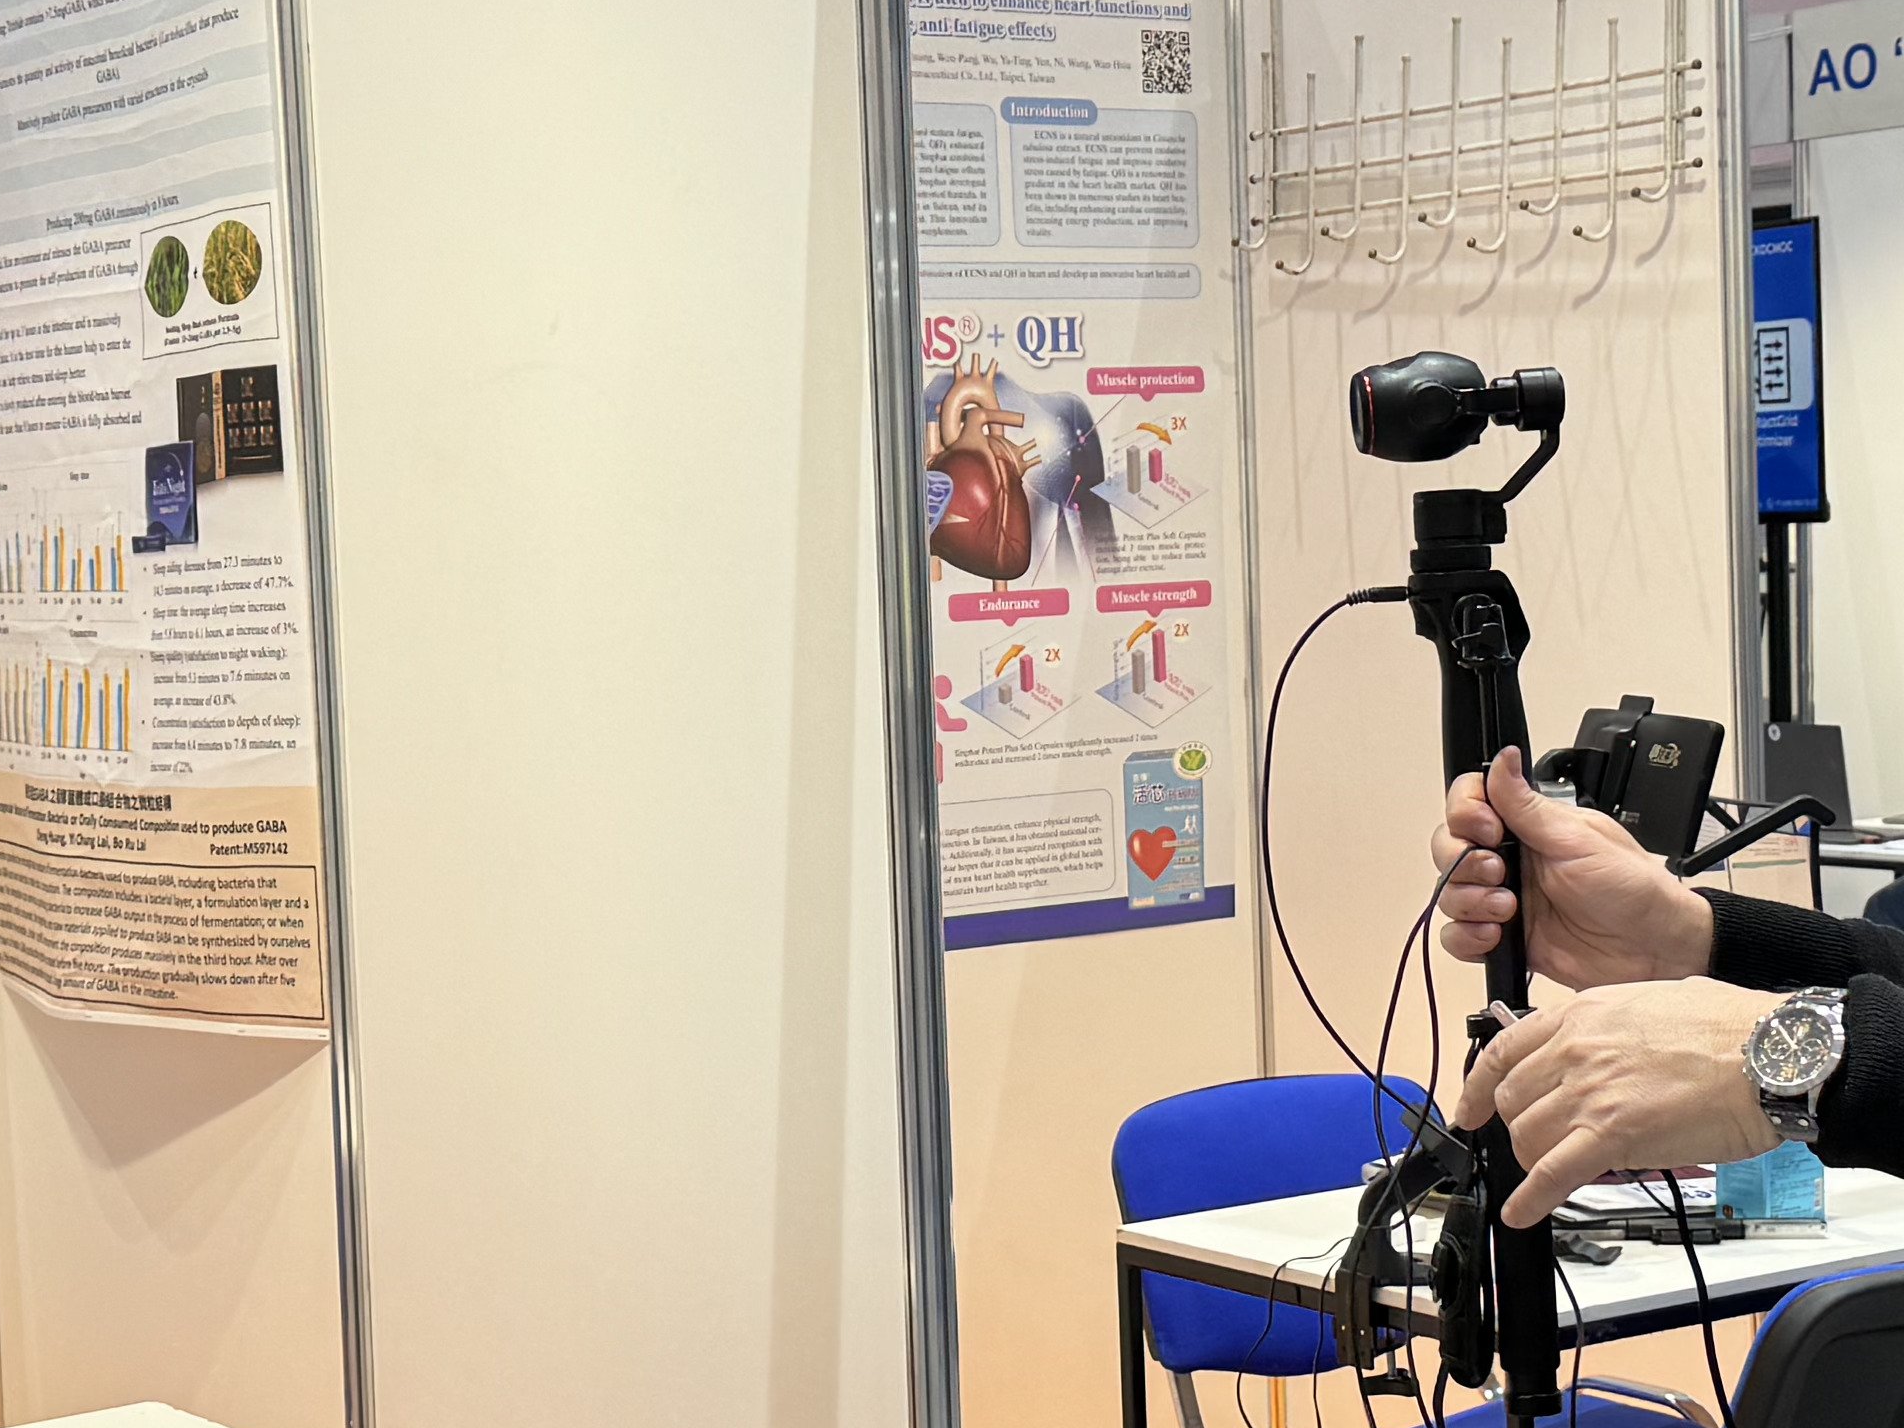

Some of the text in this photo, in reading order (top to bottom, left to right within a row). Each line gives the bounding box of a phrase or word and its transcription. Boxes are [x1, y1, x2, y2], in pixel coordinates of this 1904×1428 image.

[1095, 1, 1159, 16] functions
[1164, 4, 1190, 18] and
[1008, 22, 1054, 39] effects
[1809, 43, 1877, 96] АО
[1011, 102, 1089, 119] Introduction
[1017, 315, 1080, 362] QH
[1096, 373, 1195, 389] Muscle protection
[1171, 417, 1187, 430] 3X
[1112, 588, 1197, 604] Muscle strength
[979, 598, 1039, 611] Endurance
[1174, 623, 1189, 637] 2X
[1046, 648, 1061, 661] 2X
[200, 824, 209, 834] to
[212, 821, 253, 837] produce
[257, 820, 287, 833] GABA
